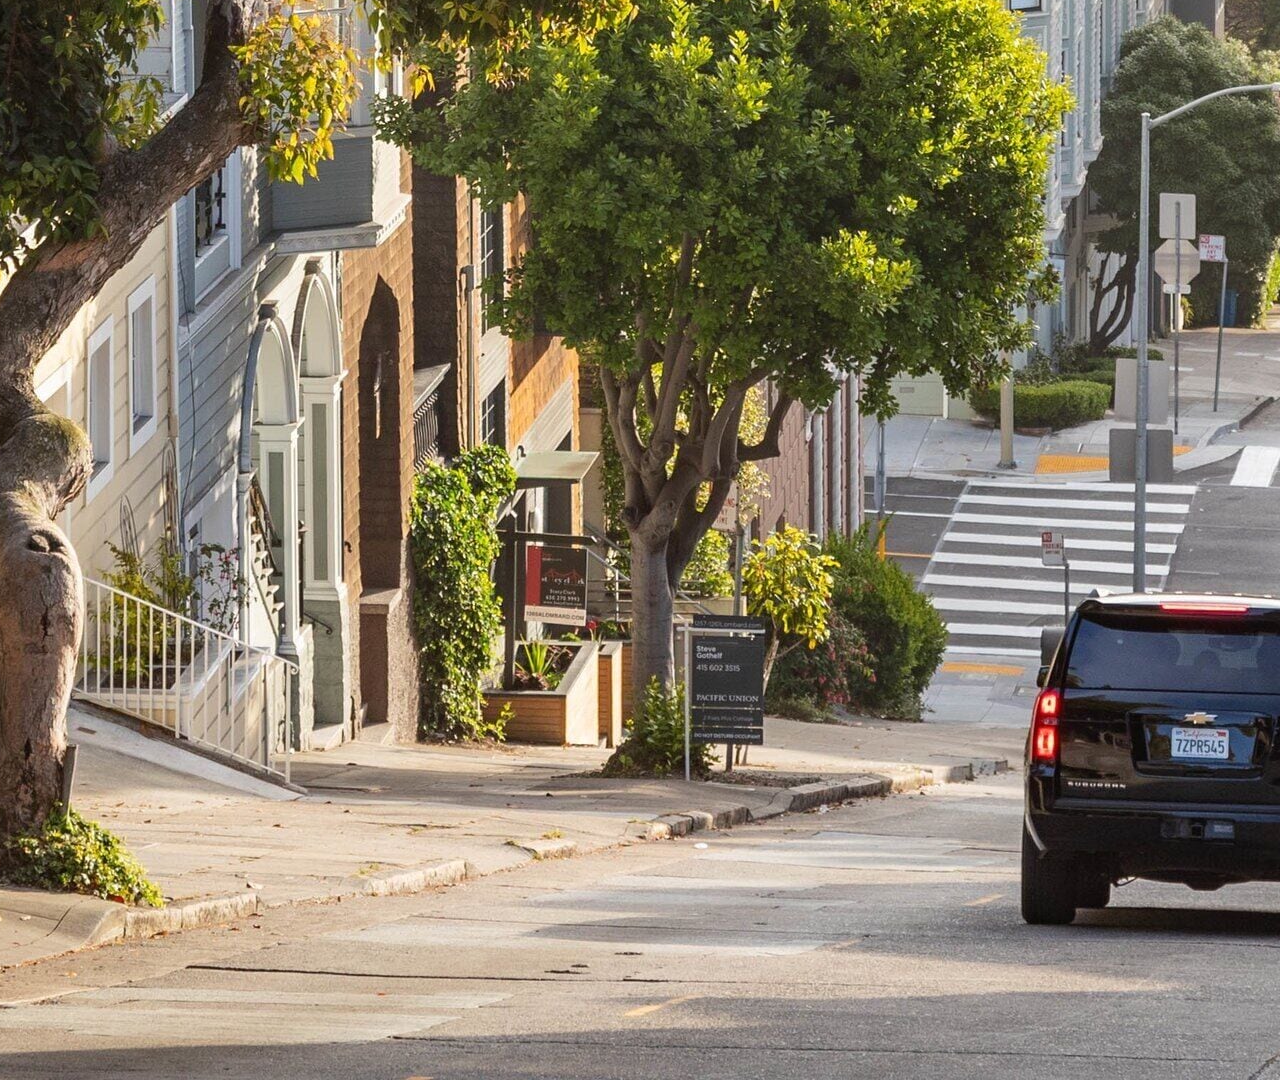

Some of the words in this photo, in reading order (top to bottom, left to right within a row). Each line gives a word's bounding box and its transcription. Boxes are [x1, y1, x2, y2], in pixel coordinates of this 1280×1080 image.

[1043, 533, 1051, 541] NO
[696, 645, 717, 653] Steve
[696, 652, 723, 660] Gothelf
[696, 664, 708, 672] 415
[709, 664, 724, 672] 602
[696, 694, 728, 702] PACIFIC
[729, 695, 759, 703] UNION
[1175, 739, 1225, 754] 7ZPR545
[1067, 781, 1126, 789] SUBURBAN
